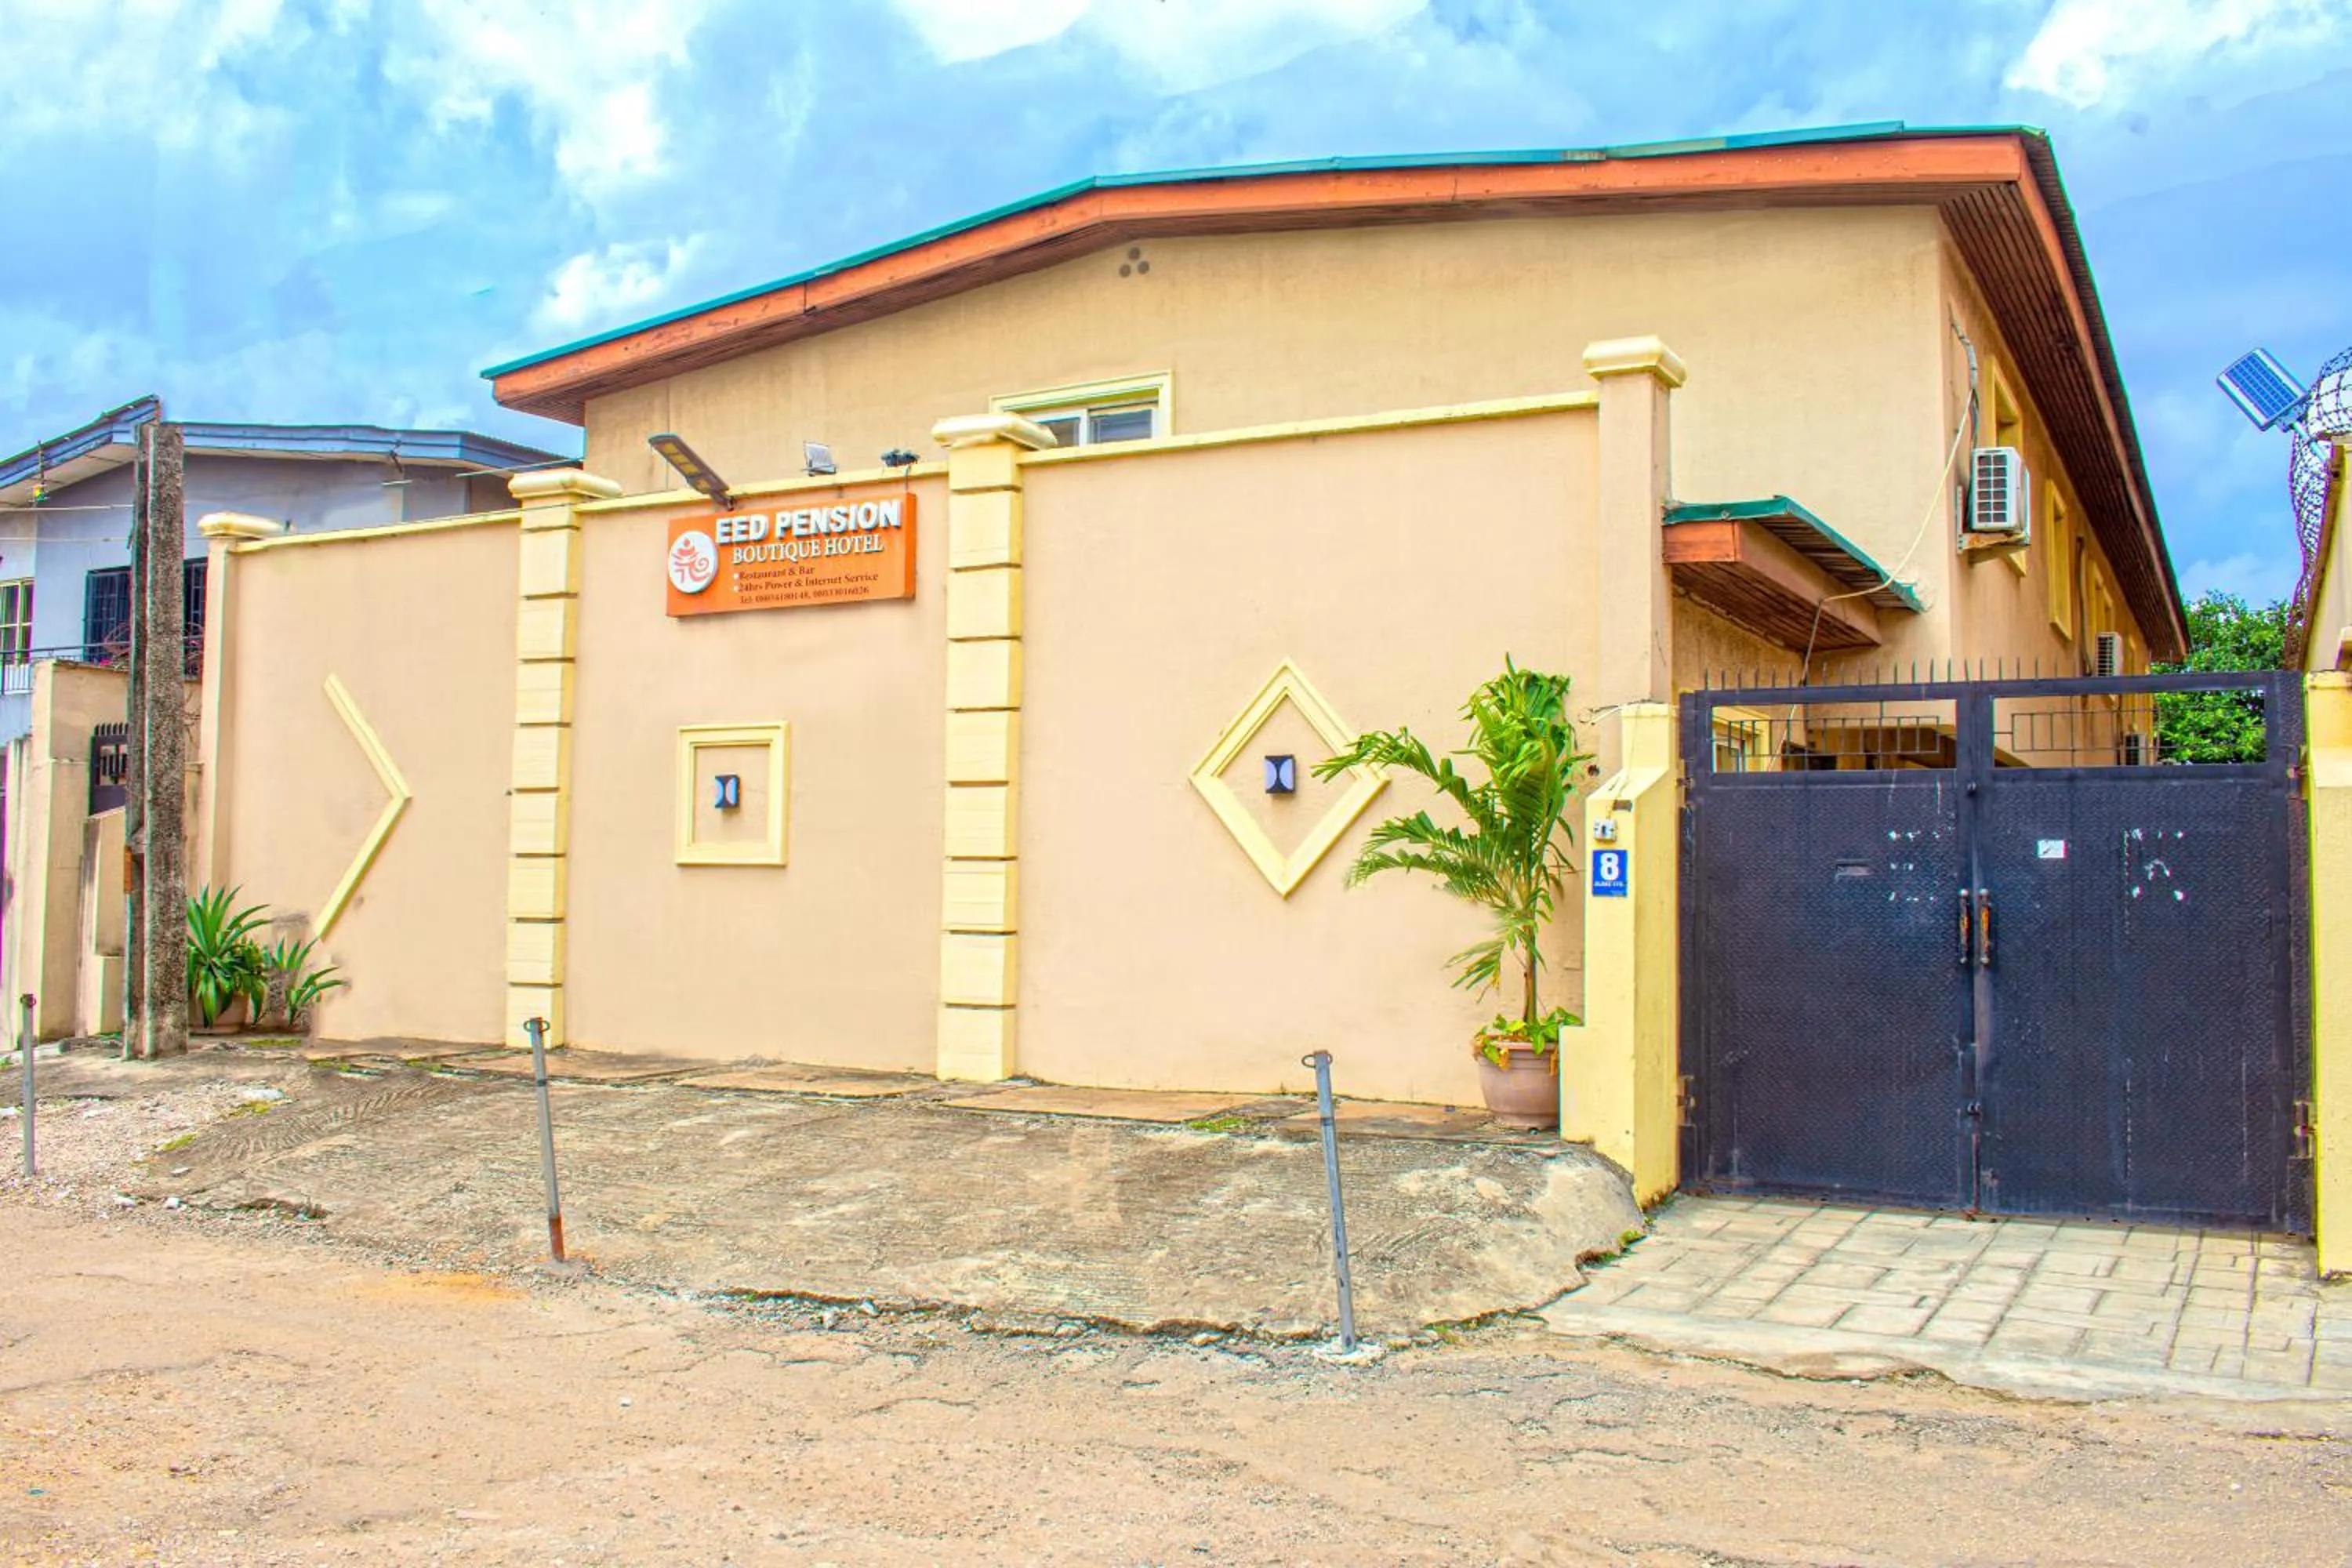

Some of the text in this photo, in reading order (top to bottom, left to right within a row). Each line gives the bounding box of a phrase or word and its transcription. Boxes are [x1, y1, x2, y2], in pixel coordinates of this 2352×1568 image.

[715, 500, 902, 545] EED PENSION
[731, 534, 884, 564] BOUTIQUE HOTEL
[739, 565, 815, 582] Restaurant & Bar
[739, 572, 880, 593] 24hrs Power & Internet Service
[1600, 852, 1619, 880] 8
